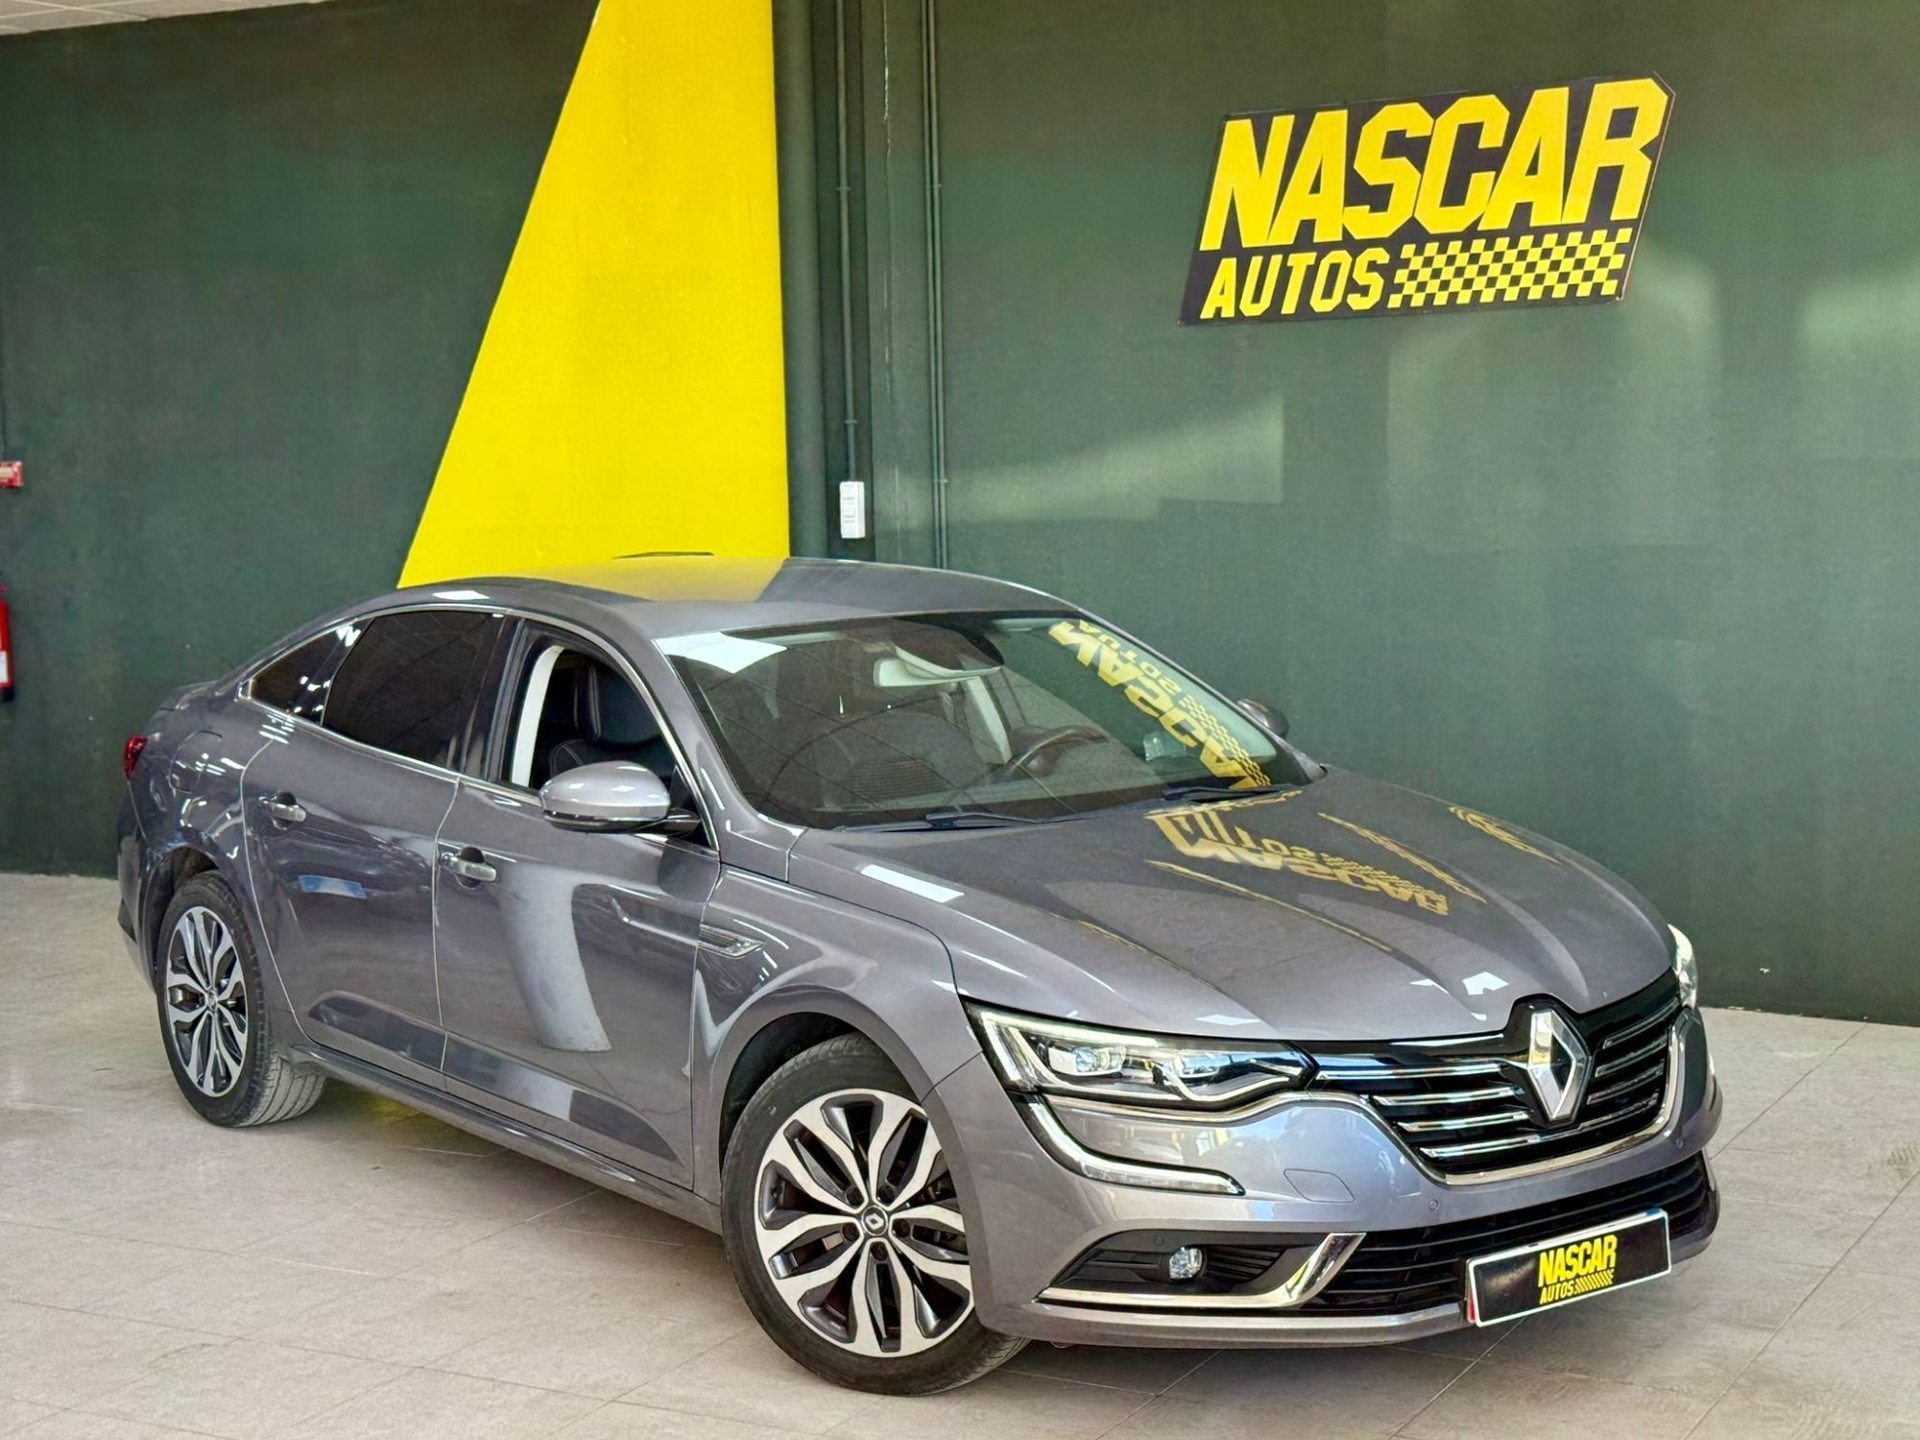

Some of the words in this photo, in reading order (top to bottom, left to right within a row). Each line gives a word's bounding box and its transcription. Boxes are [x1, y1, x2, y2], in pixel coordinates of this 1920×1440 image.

[1199, 78, 1669, 251] NASCAR
[1200, 248, 1391, 320] AUTOS
[1538, 1235, 1617, 1287] NASCAR
[1540, 1280, 1574, 1304] AUTOS
